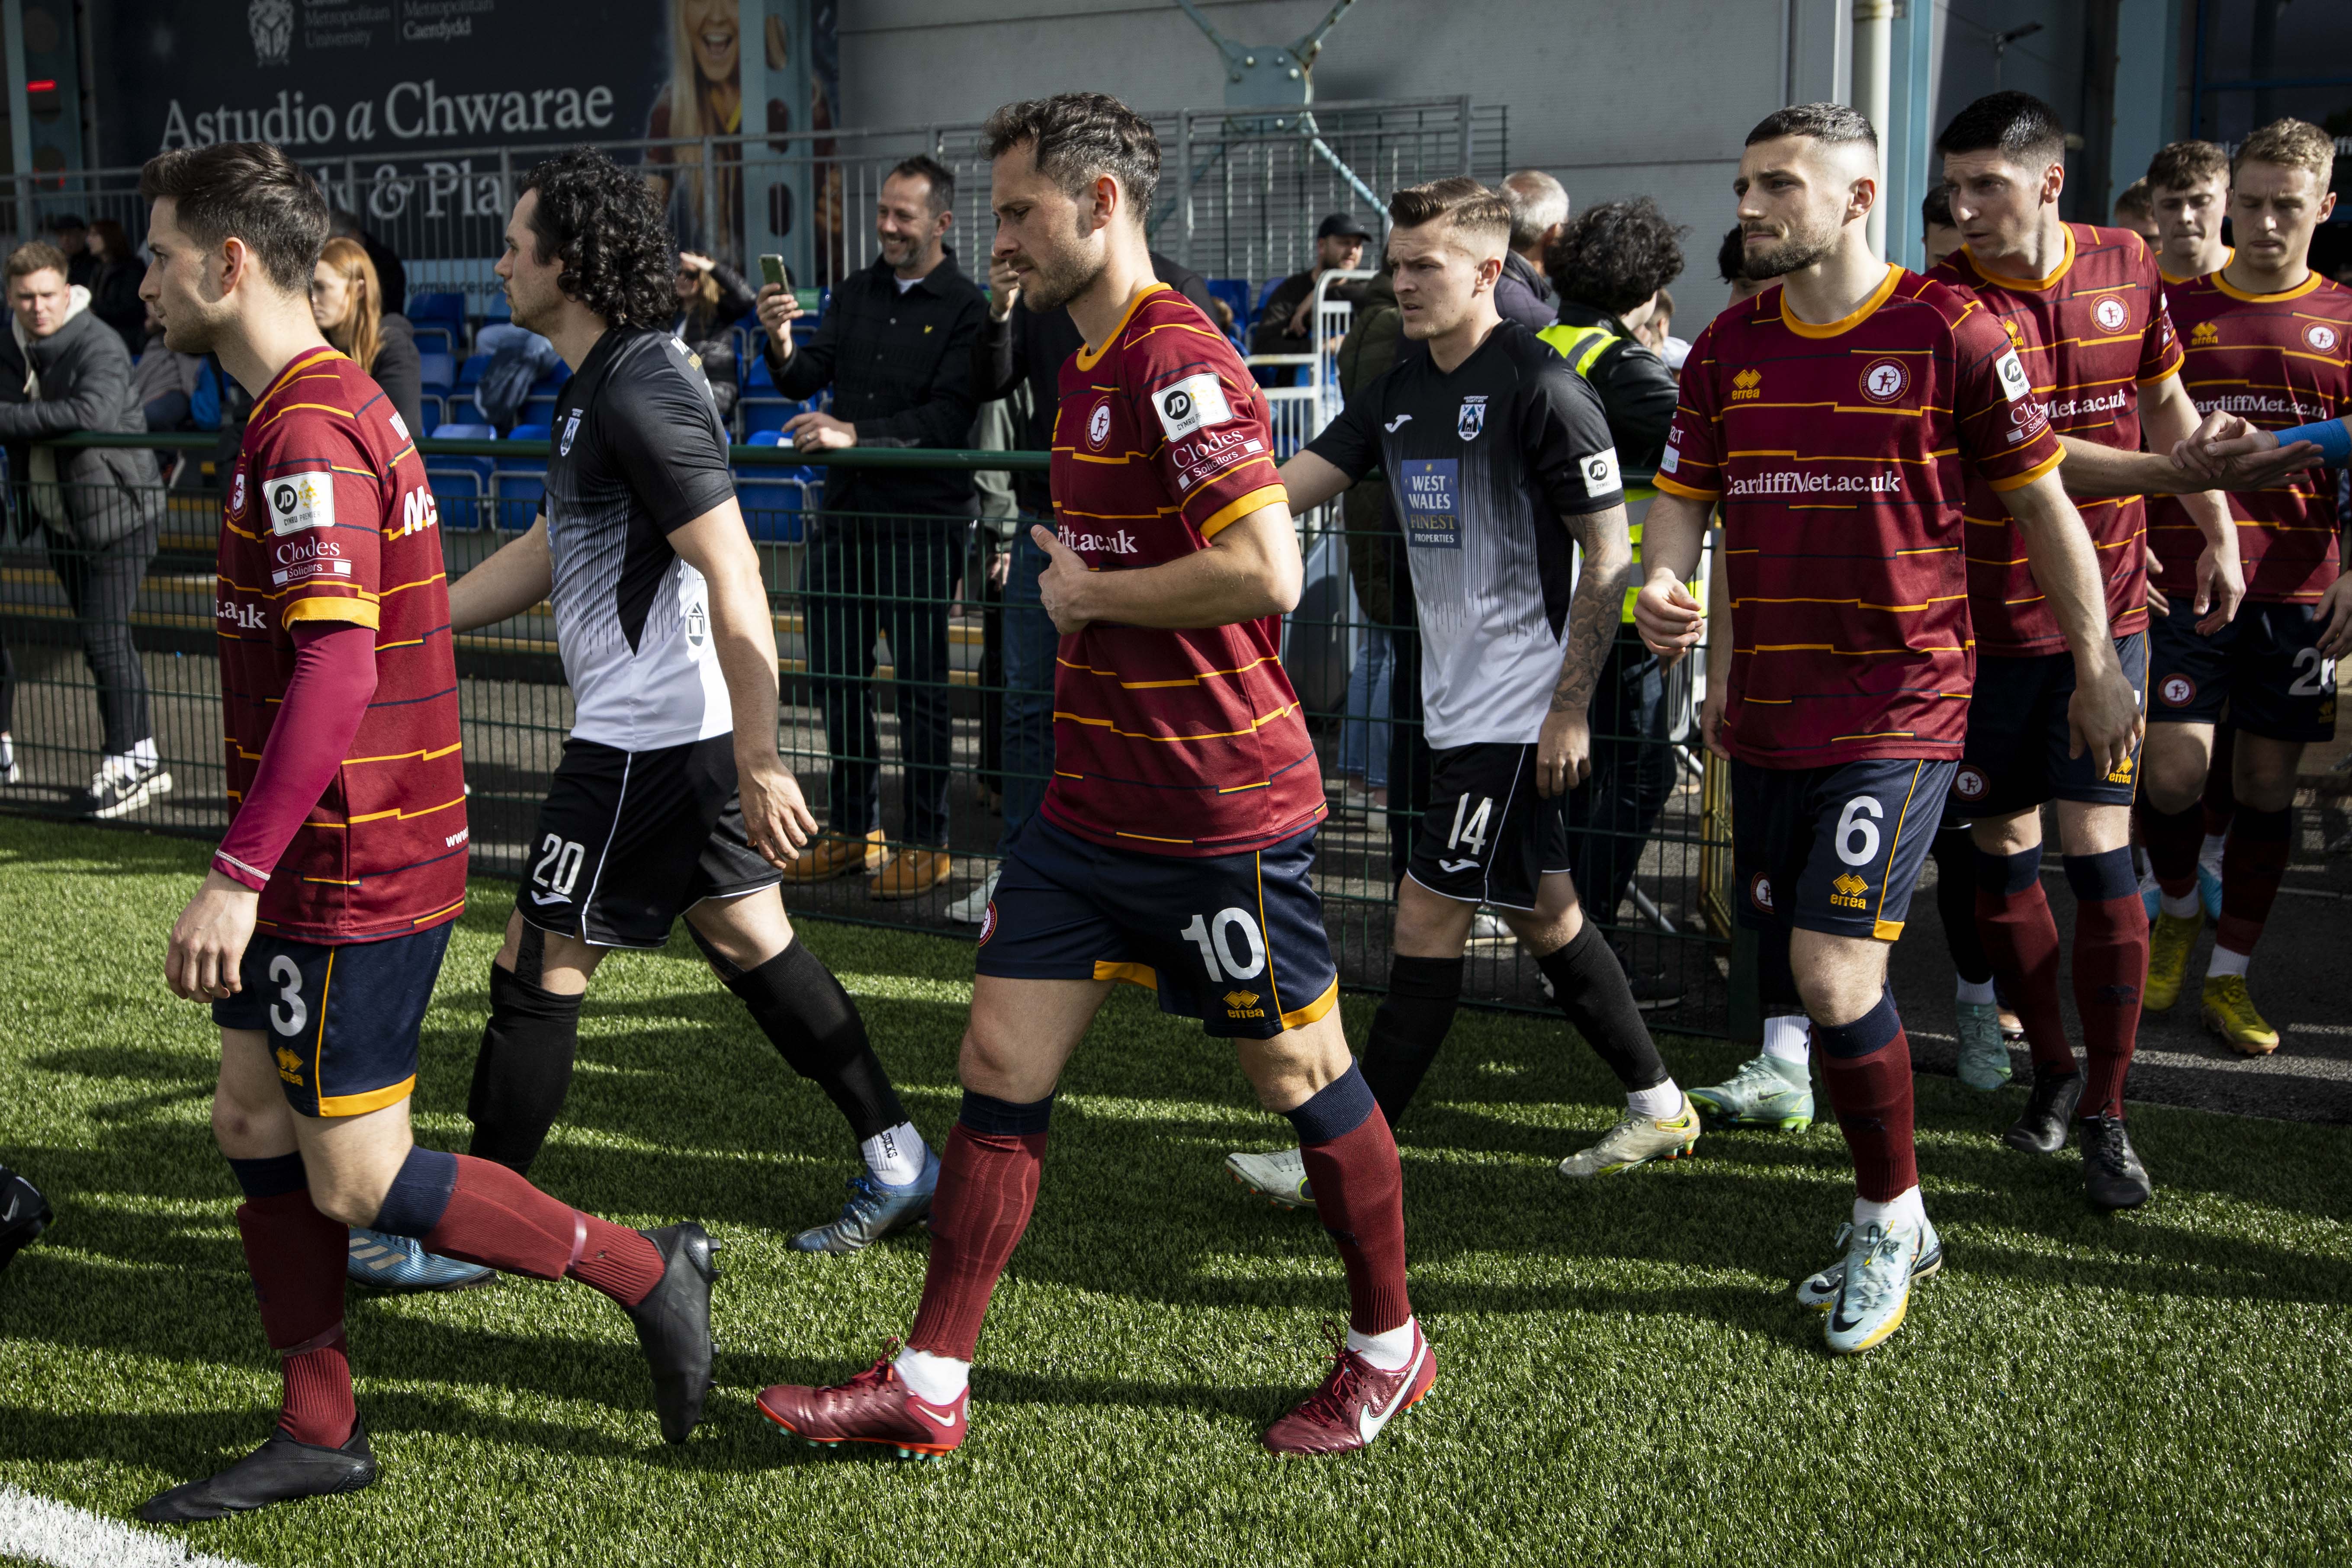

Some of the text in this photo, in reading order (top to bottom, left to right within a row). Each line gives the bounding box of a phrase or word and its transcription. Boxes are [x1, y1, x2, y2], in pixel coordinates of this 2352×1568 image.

[403, 16, 472, 42] Caerdydd
[160, 78, 614, 151] Astudio a Chwarae
[423, 158, 504, 217] Pla
[2008, 360, 2021, 380] JD
[1732, 389, 1760, 401] errea
[1169, 395, 1188, 417] JD
[1176, 418, 1195, 431] CYMRU
[1173, 430, 1244, 469] Clodes
[1193, 451, 1239, 476] Solicitors
[1592, 462, 1607, 478] JD
[1412, 475, 1446, 492] WEST
[278, 490, 294, 509] JD
[1408, 493, 1451, 509] WALES
[283, 516, 298, 526] CYMRU
[1410, 514, 1456, 530] FINEST
[1415, 533, 1454, 543] PROPERTIES
[276, 536, 340, 564] Clodes
[288, 563, 323, 577] Solicitors
[2108, 772, 2131, 784] errea
[1448, 792, 1493, 855] 14
[1835, 795, 1883, 866] 6
[533, 833, 585, 895] 20
[1830, 893, 1867, 909] errea
[1180, 907, 1266, 982] 10
[269, 954, 308, 1037] 3
[1227, 1007, 1265, 1019] errea
